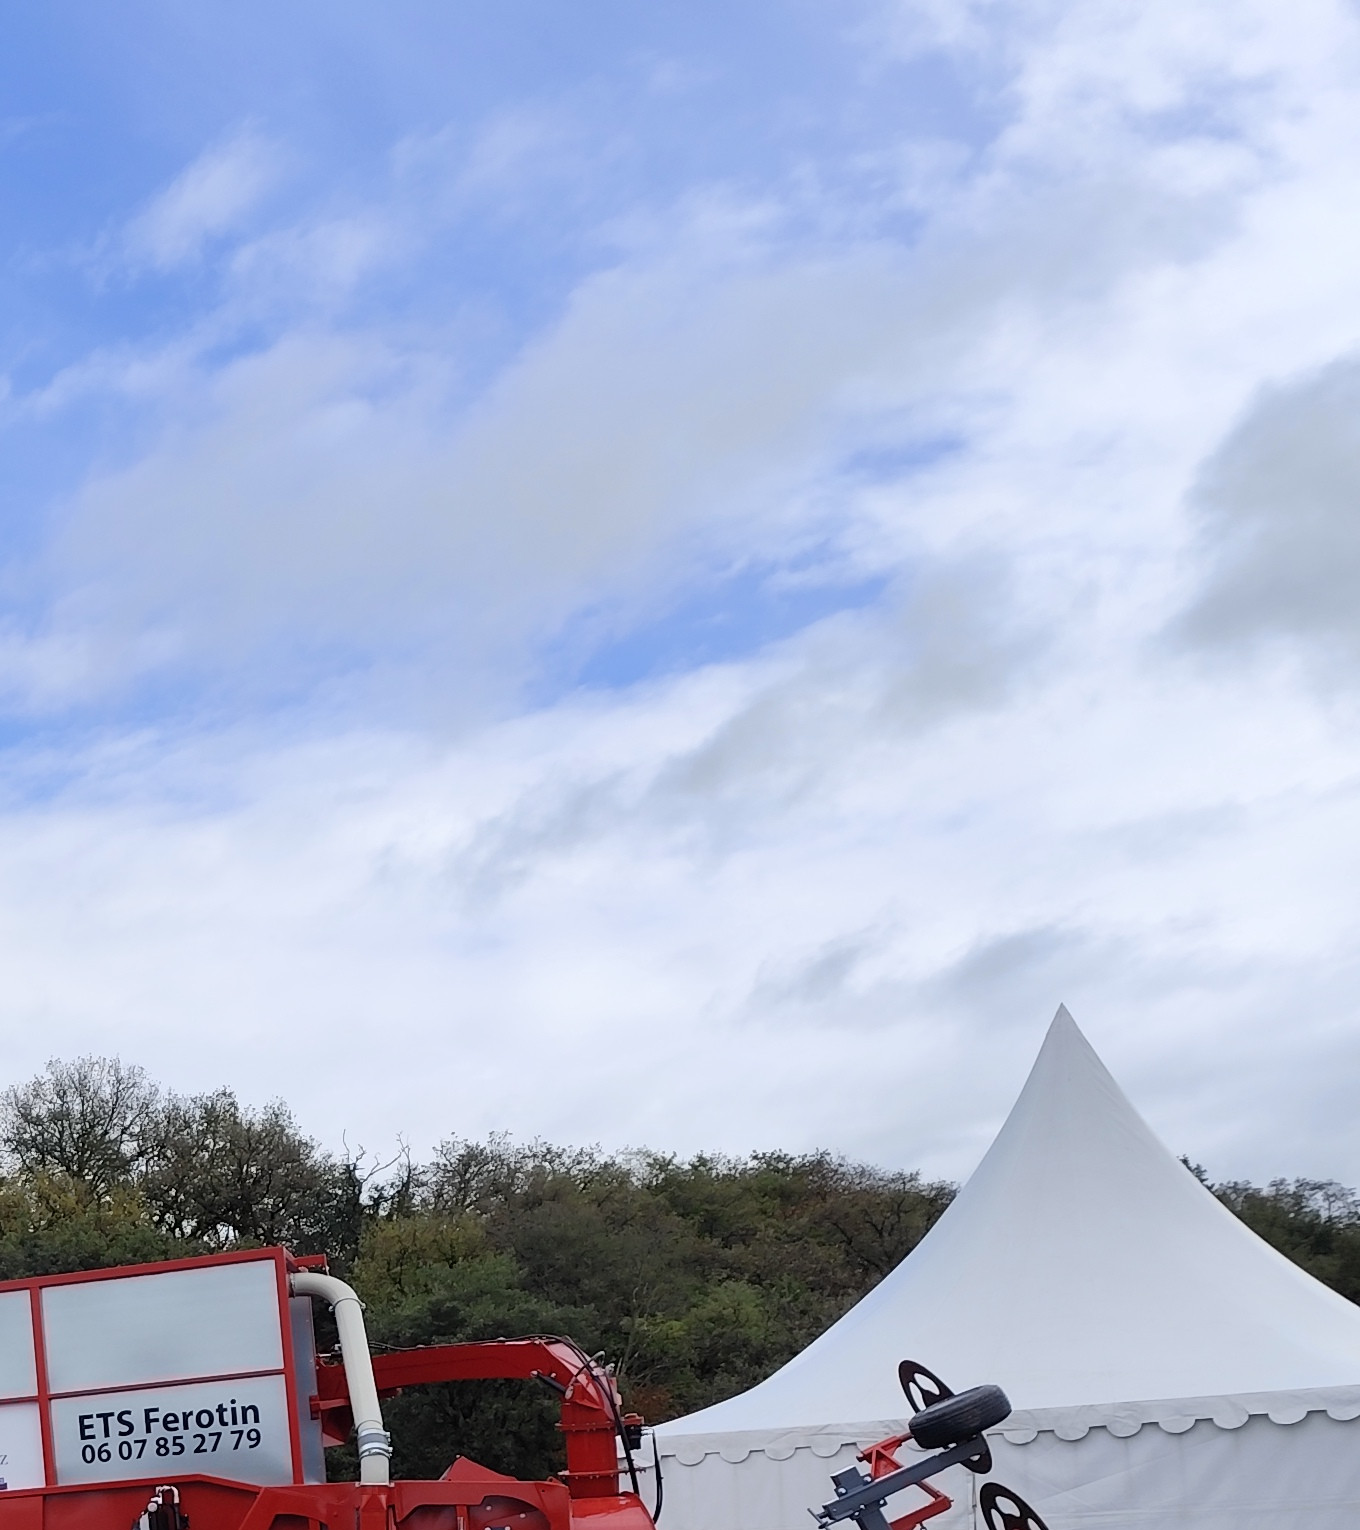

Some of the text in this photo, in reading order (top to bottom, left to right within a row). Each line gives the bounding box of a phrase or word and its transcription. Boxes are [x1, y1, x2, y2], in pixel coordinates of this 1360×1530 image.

[78, 1398, 261, 1441] ETS Ferotin
[81, 1428, 261, 1464] 06 07 85 27 79
